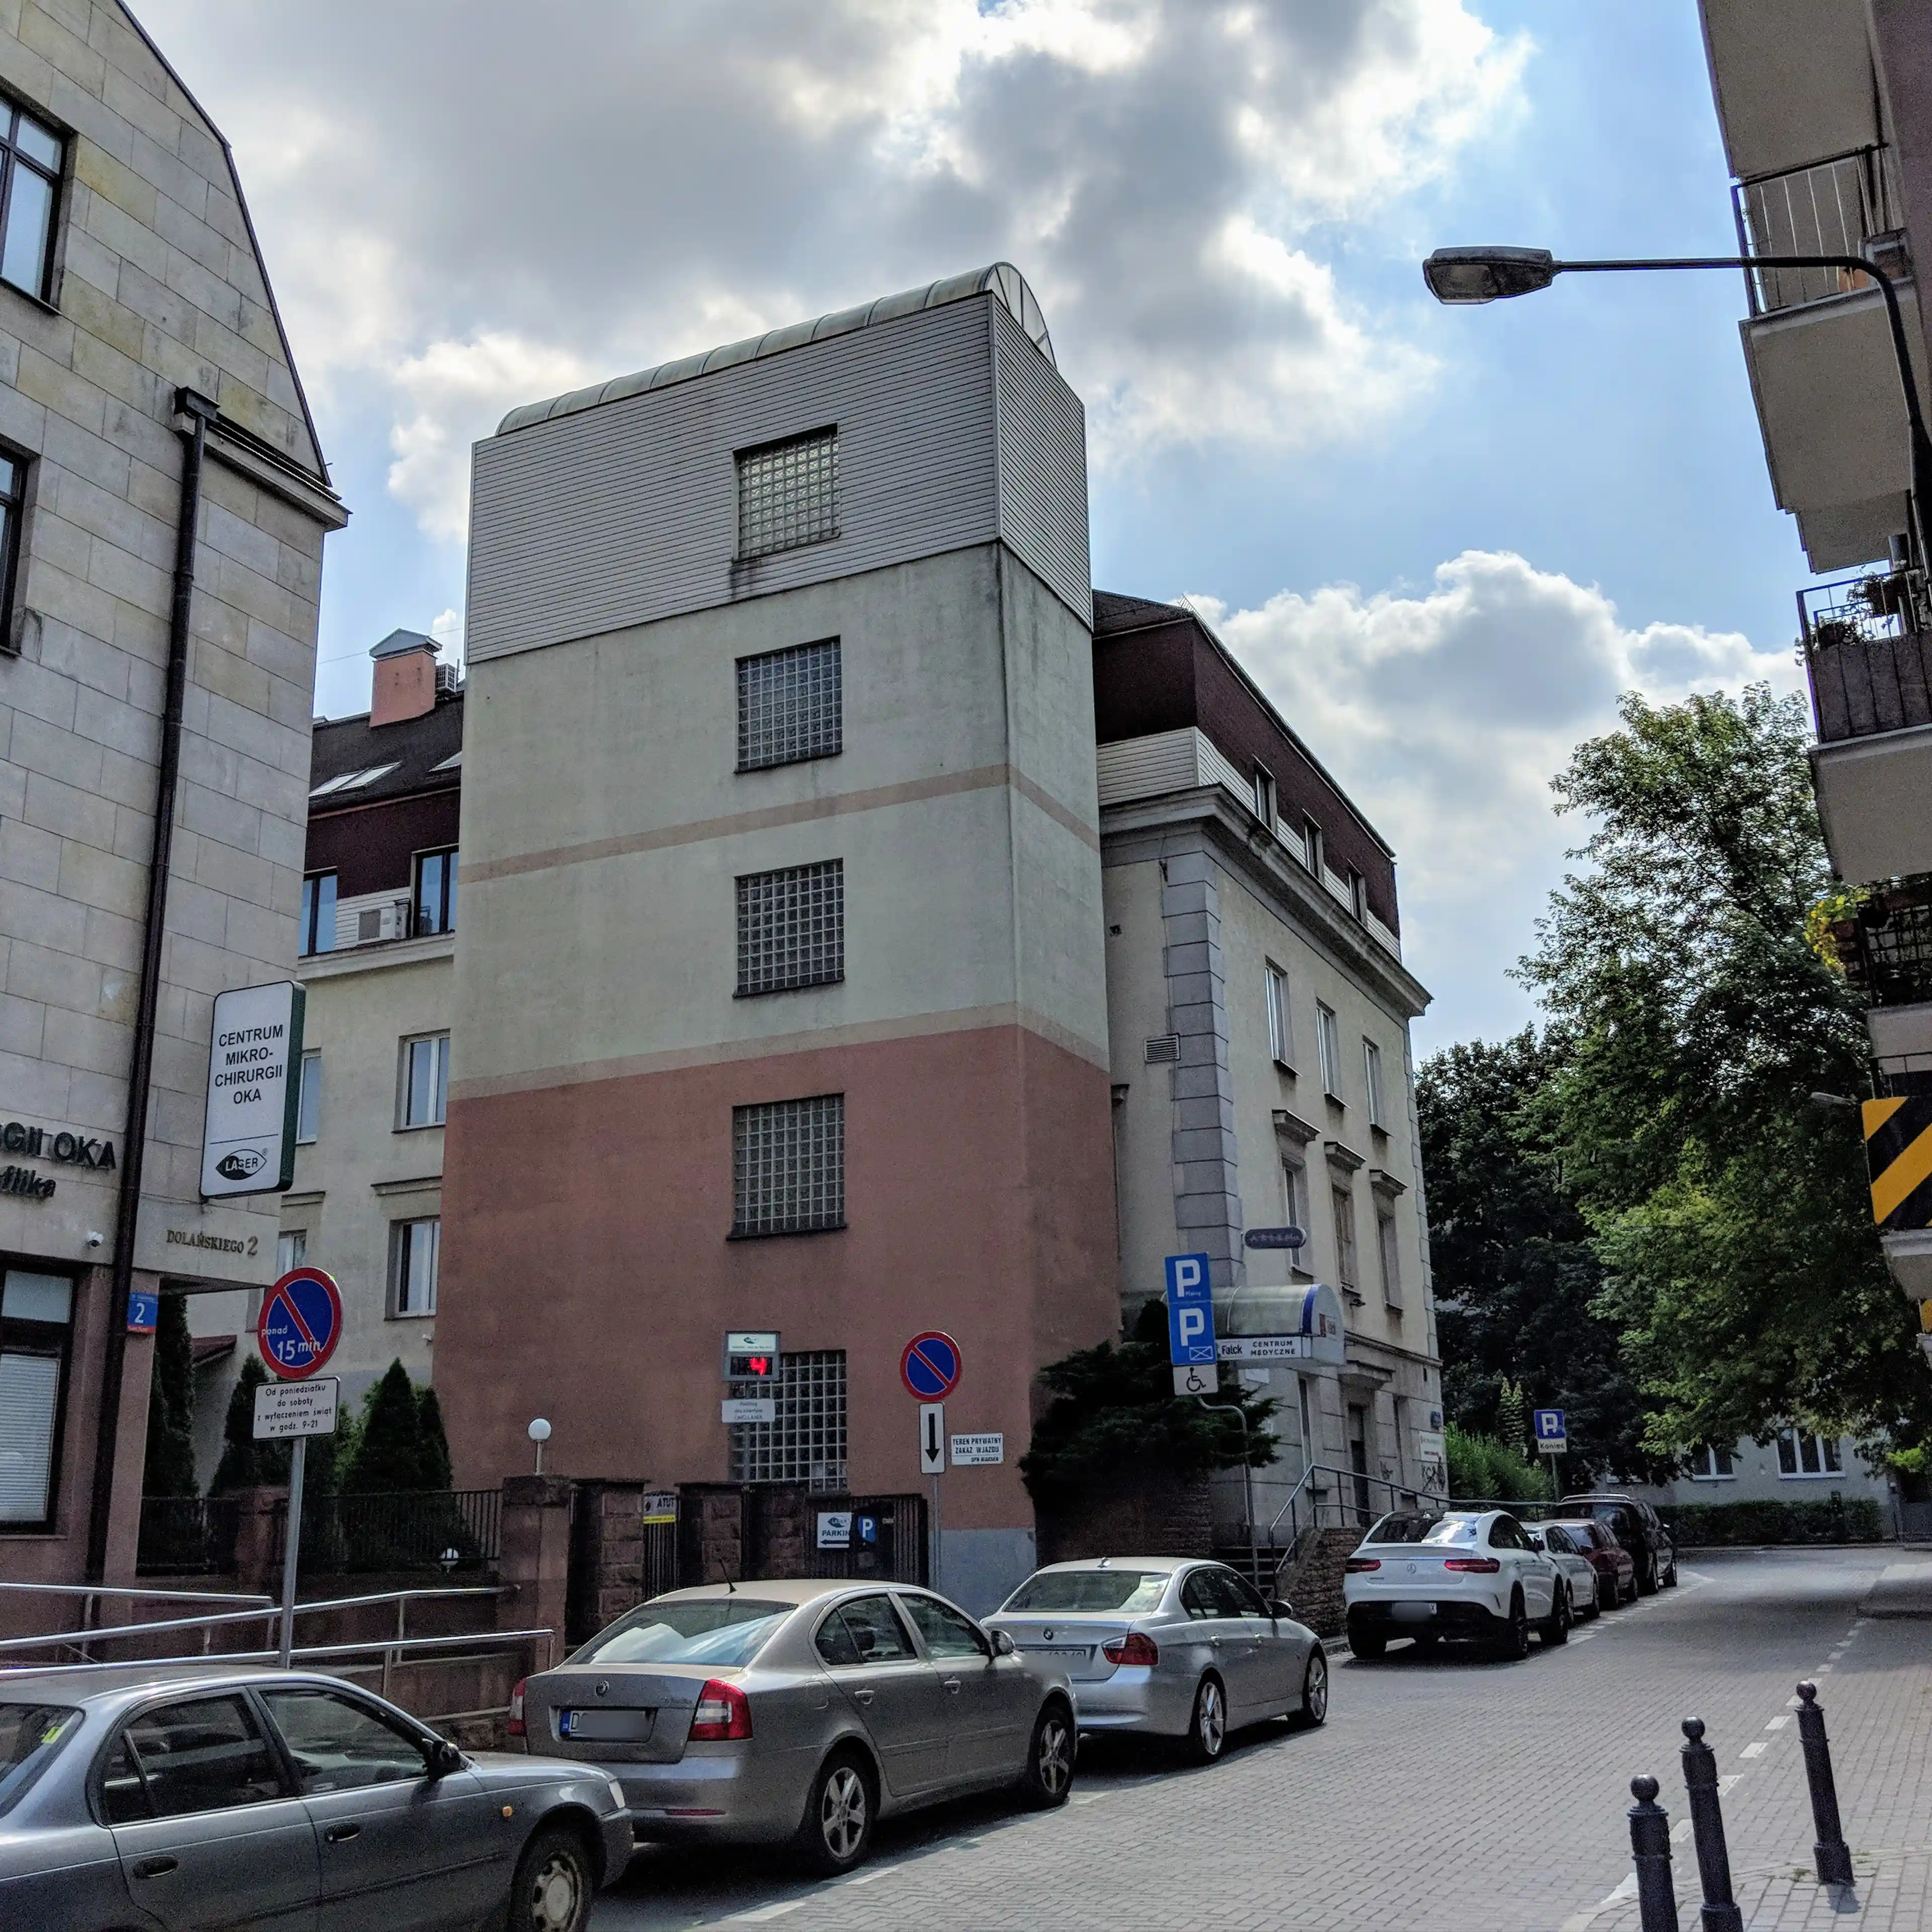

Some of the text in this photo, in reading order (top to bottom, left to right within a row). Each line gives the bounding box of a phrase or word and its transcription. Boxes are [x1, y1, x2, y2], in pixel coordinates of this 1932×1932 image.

[219, 1024, 283, 1046] CENTRUM
[226, 1047, 273, 1066] MIKRO-
[215, 1065, 282, 1087] CHIRURGII
[233, 1088, 262, 1104] OKA
[54, 1132, 116, 1170] OKA
[225, 1157, 258, 1172] LASER
[167, 1230, 258, 1256] DOLAŃSKIEGO 2
[1175, 1259, 1201, 1298] P
[135, 1303, 145, 1323] 2
[261, 1325, 288, 1338] ponad
[1179, 1308, 1204, 1346] P
[277, 1337, 321, 1361] 15 min
[1221, 1344, 1243, 1355] Falck
[1251, 1348, 1296, 1356] MEDYCZNE
[750, 1356, 767, 1377] 4
[266, 1384, 326, 1398] Od poniedziałku
[290, 1397, 313, 1407] soboty
[265, 1410, 309, 1422] wyłączeniem
[313, 1407, 332, 1416] świąt
[279, 1421, 298, 1433] godz.
[302, 1419, 318, 1429] 9-21
[862, 1518, 873, 1538] P
